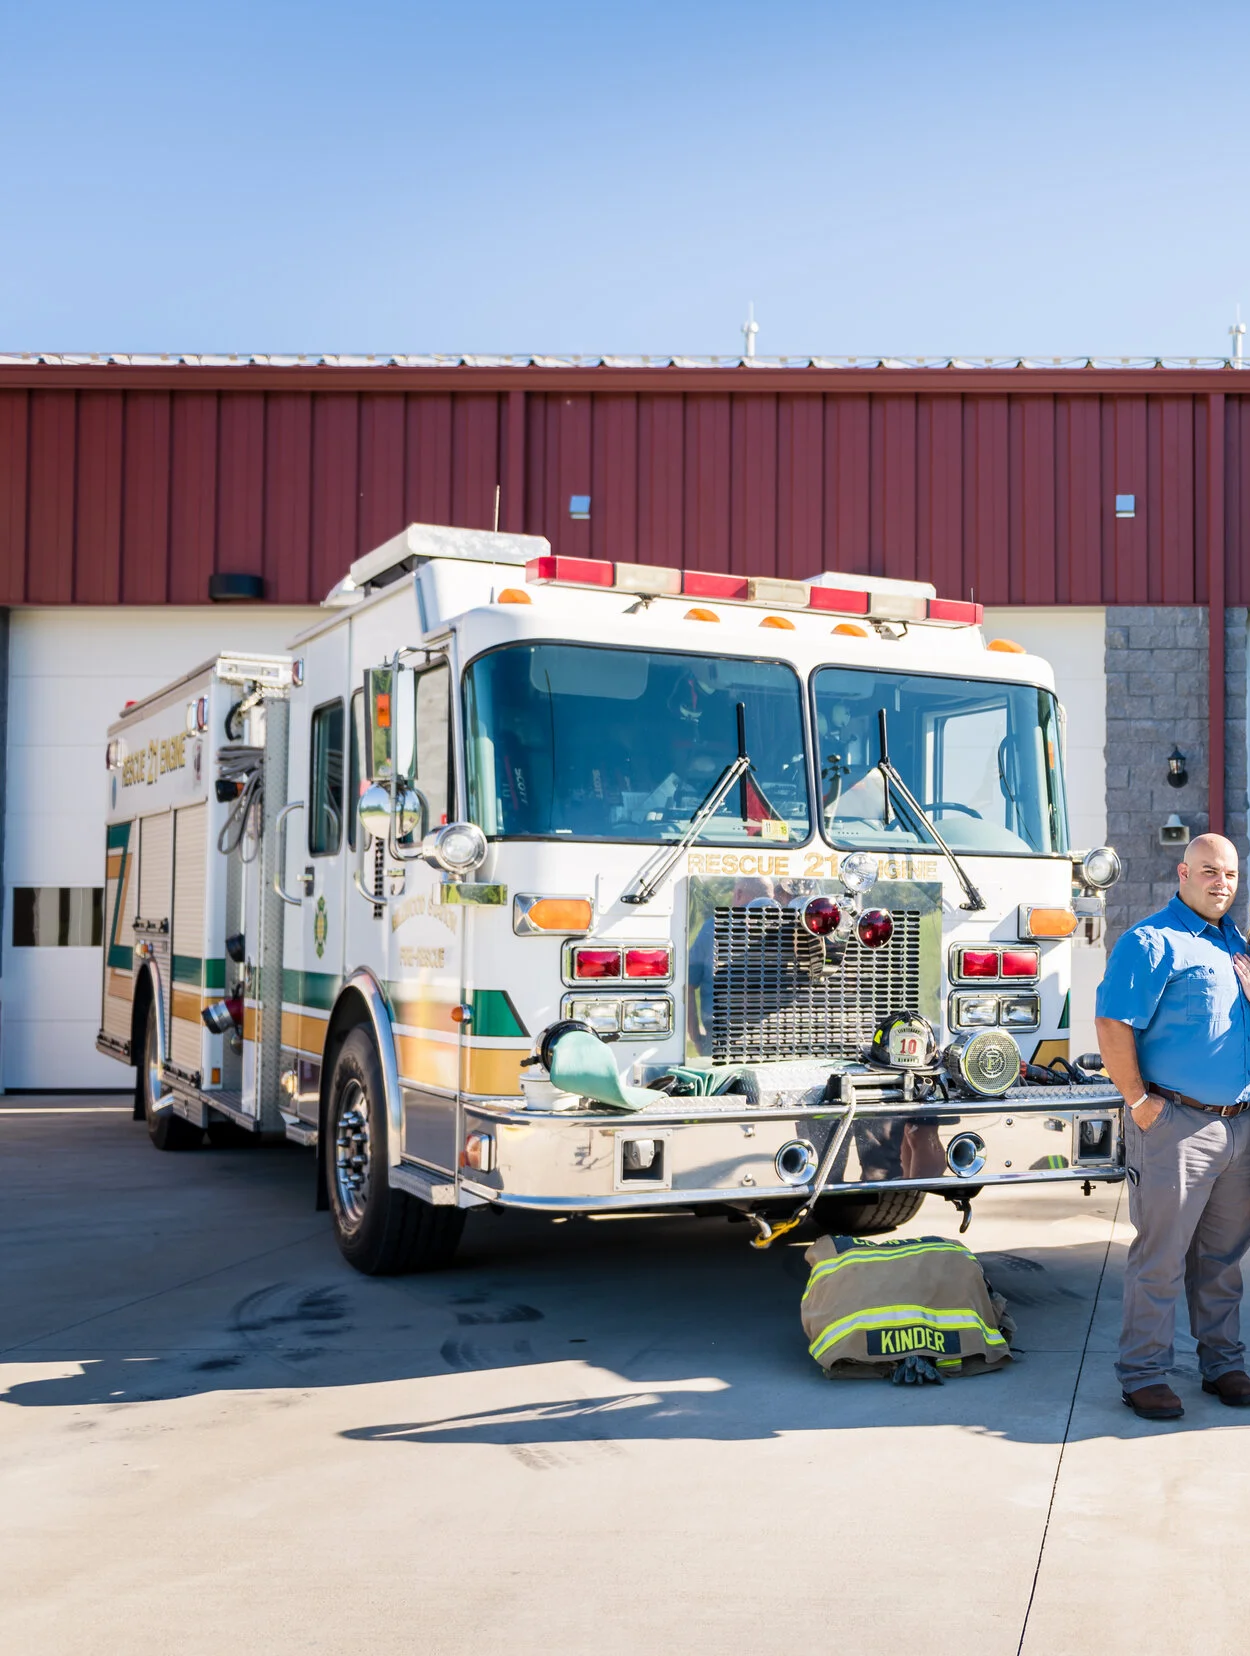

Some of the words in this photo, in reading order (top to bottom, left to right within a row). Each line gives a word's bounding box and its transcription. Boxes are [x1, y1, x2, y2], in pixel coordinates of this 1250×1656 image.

[122, 748, 146, 788] RESCUE
[147, 738, 159, 785] 21
[160, 732, 187, 775] ENGINE
[688, 853, 790, 876] RESCUE
[803, 852, 838, 877] 21
[876, 859, 938, 880] GINE
[900, 1038, 917, 1055] 10
[881, 1327, 946, 1354] KINDER
